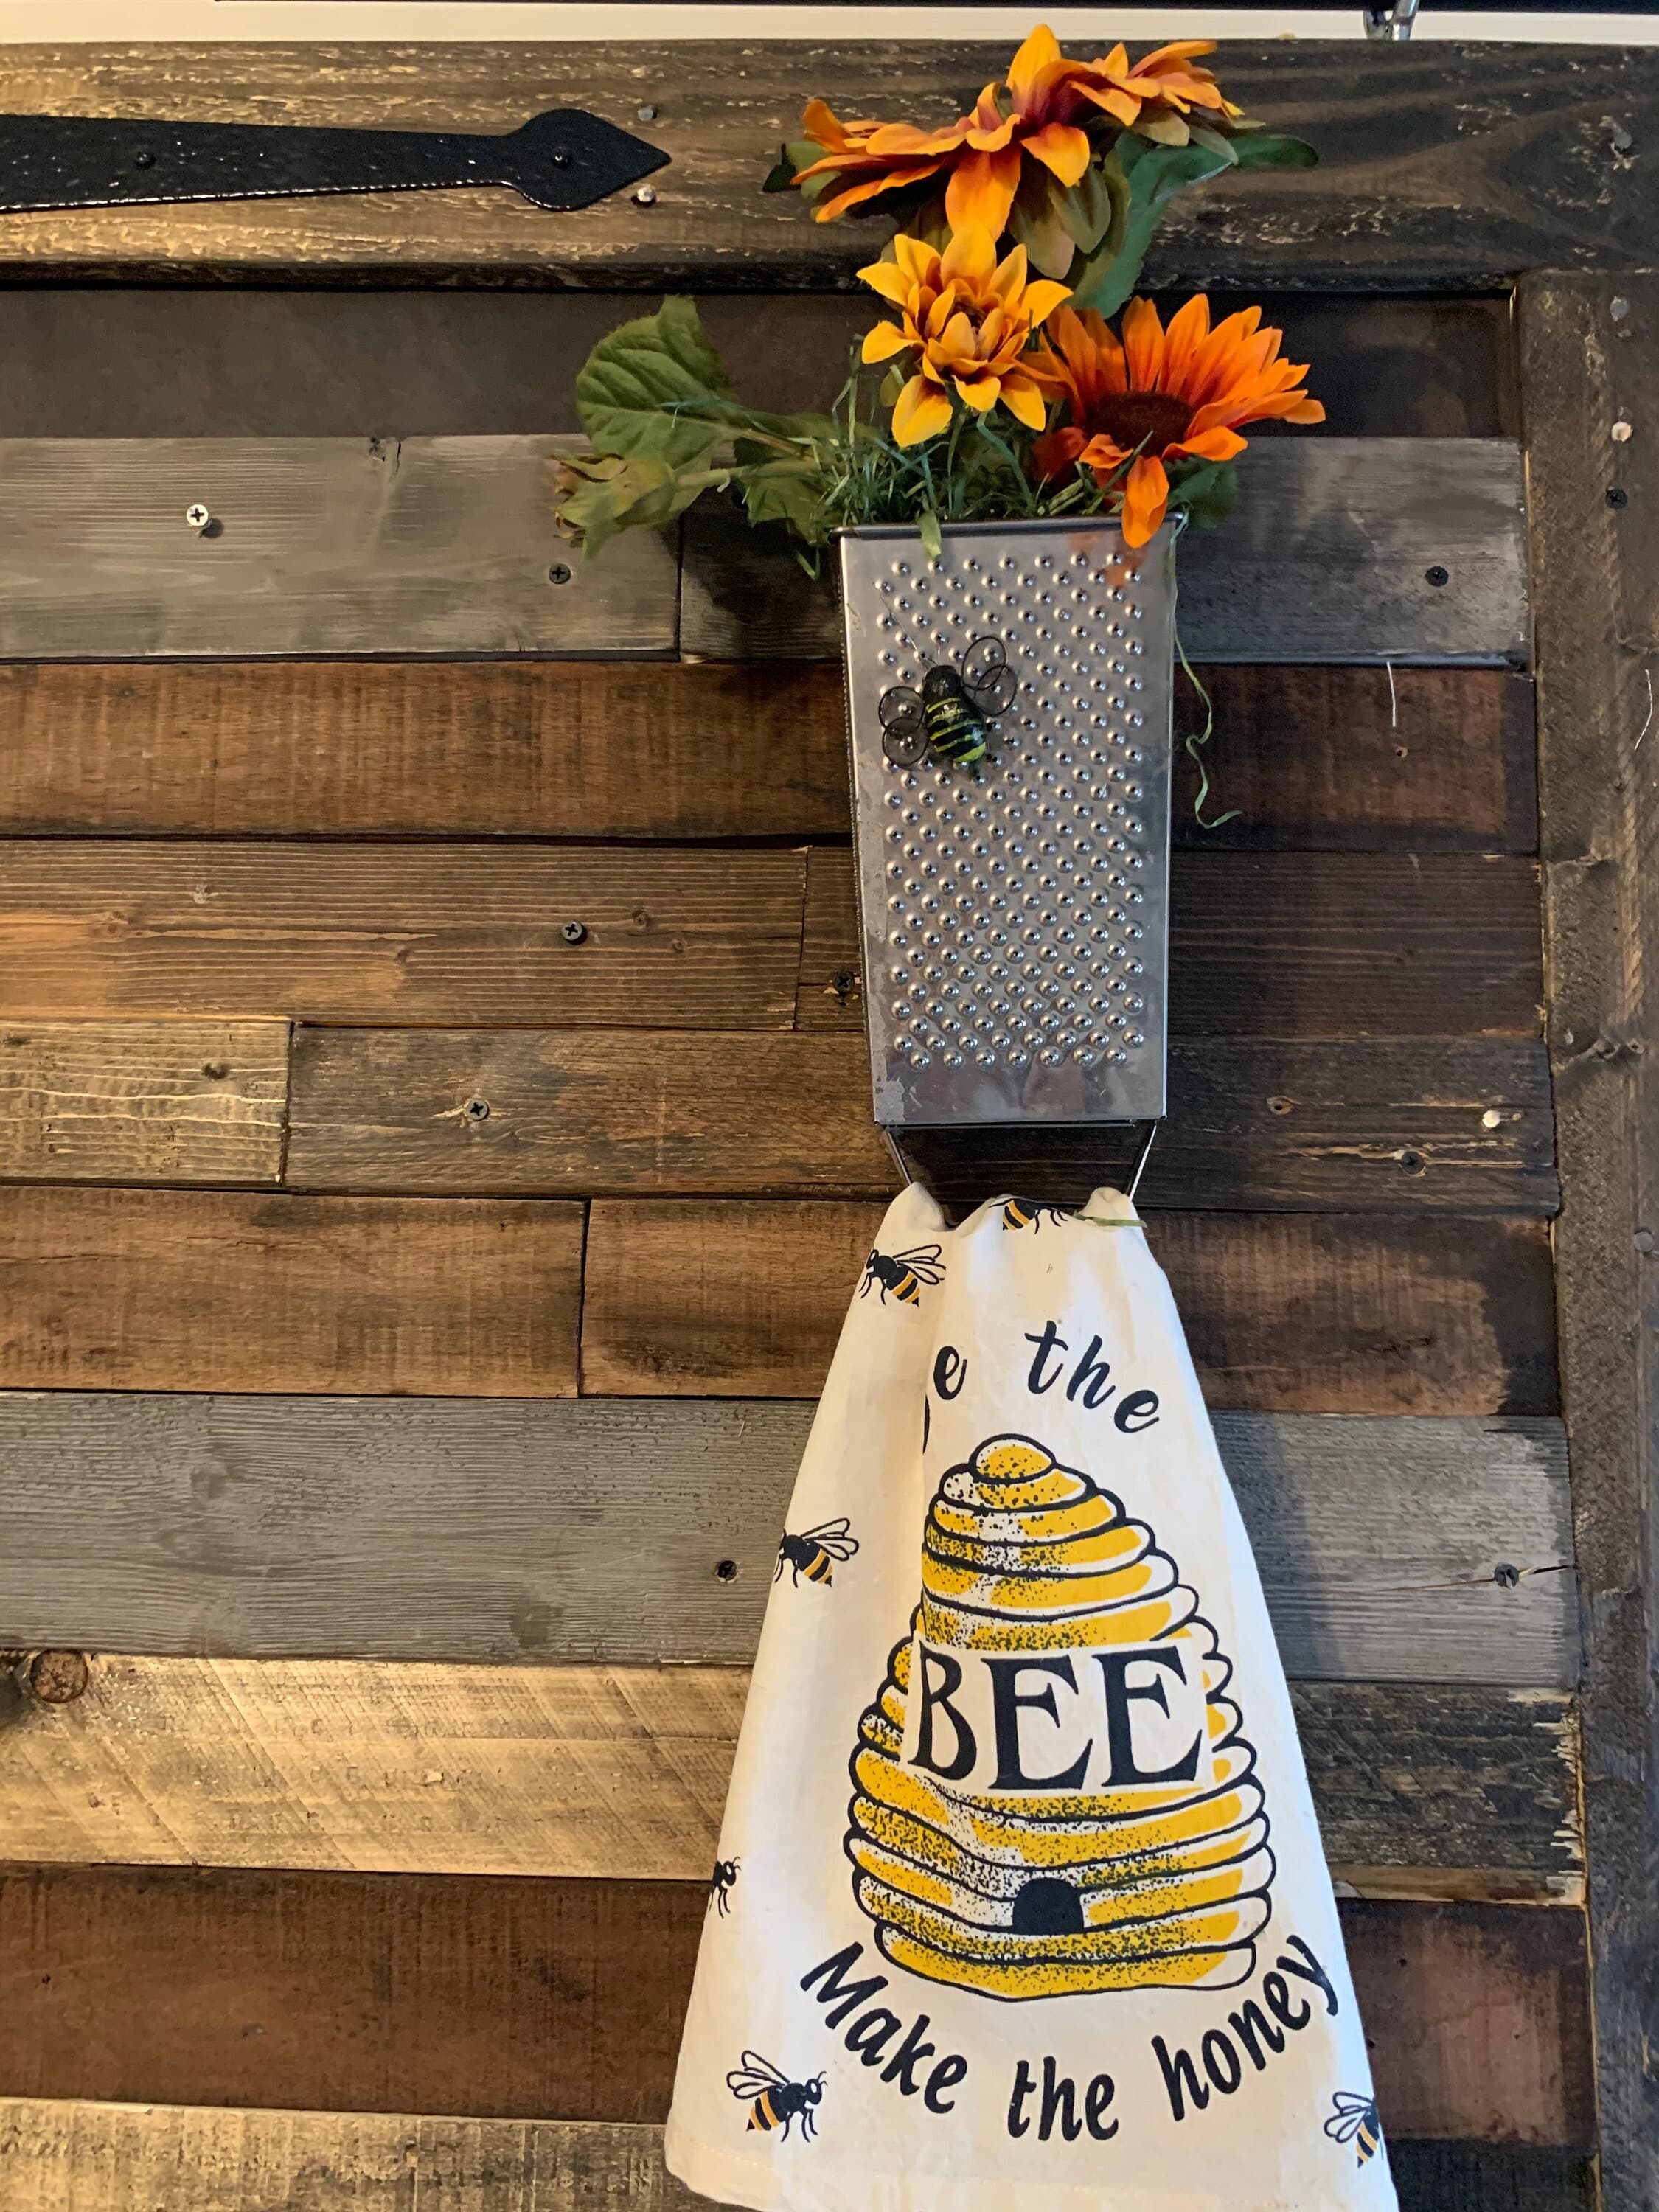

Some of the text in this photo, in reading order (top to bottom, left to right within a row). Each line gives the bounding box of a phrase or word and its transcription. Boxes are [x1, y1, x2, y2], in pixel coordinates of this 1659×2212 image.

[1024, 1320, 1160, 1433] the
[907, 1639, 1203, 1790] BEE
[800, 1935, 1338, 2142] Make the honey
